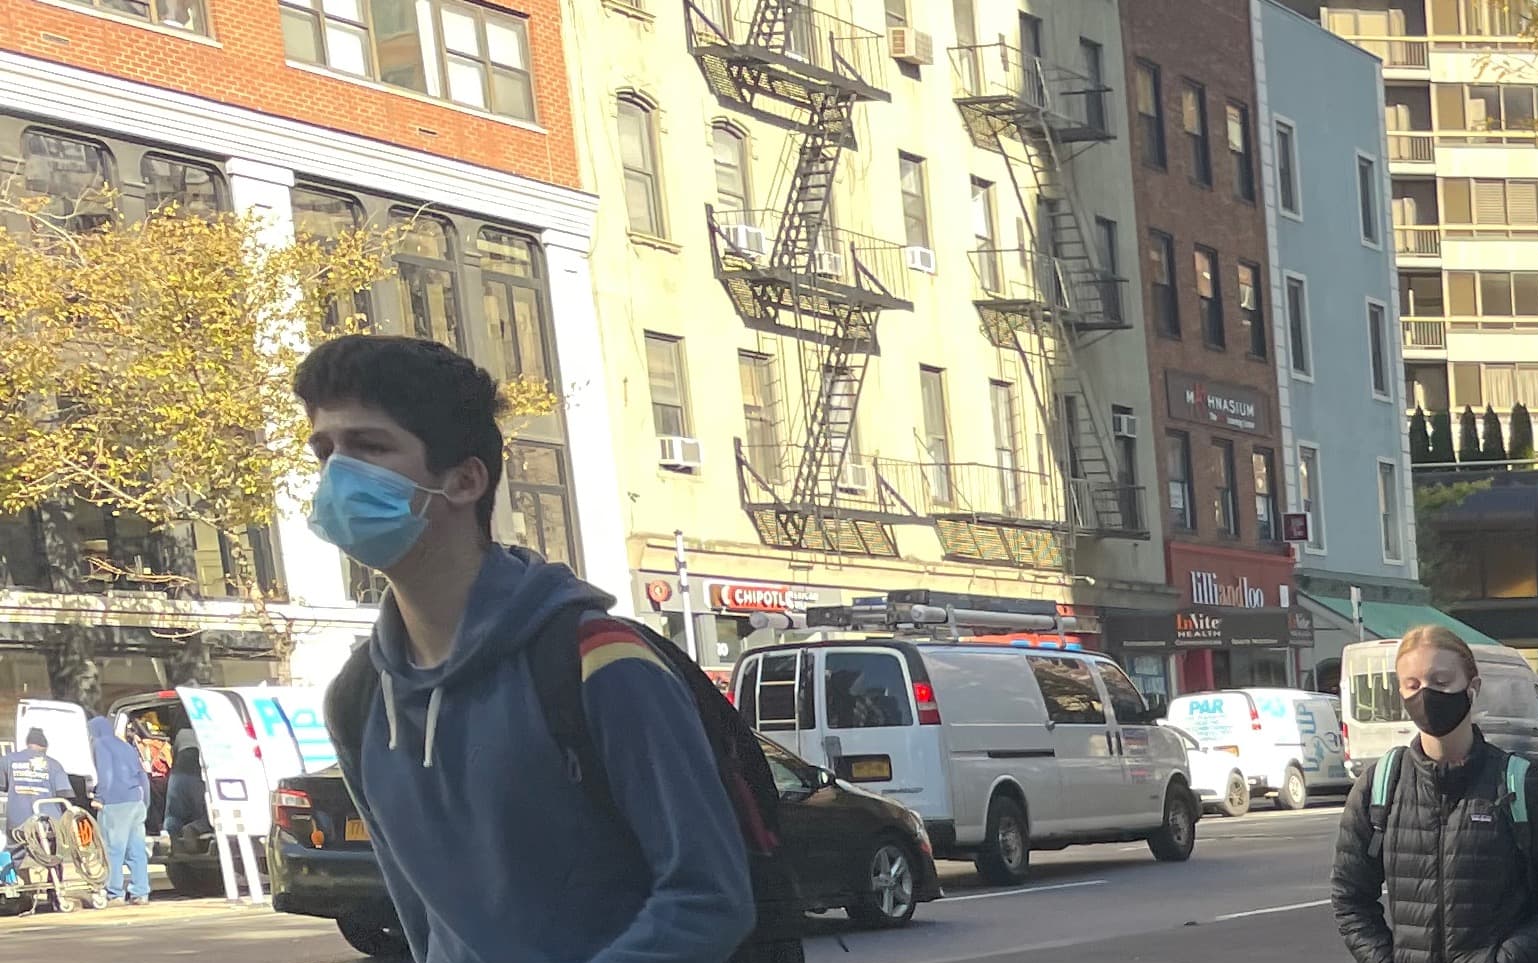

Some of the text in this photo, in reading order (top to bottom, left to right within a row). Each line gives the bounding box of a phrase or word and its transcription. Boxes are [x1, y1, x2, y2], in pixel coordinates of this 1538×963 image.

[734, 588, 795, 609] CHIPOTLE
[1177, 630, 1222, 638] HEALTH
[1188, 698, 1225, 715] PAR
